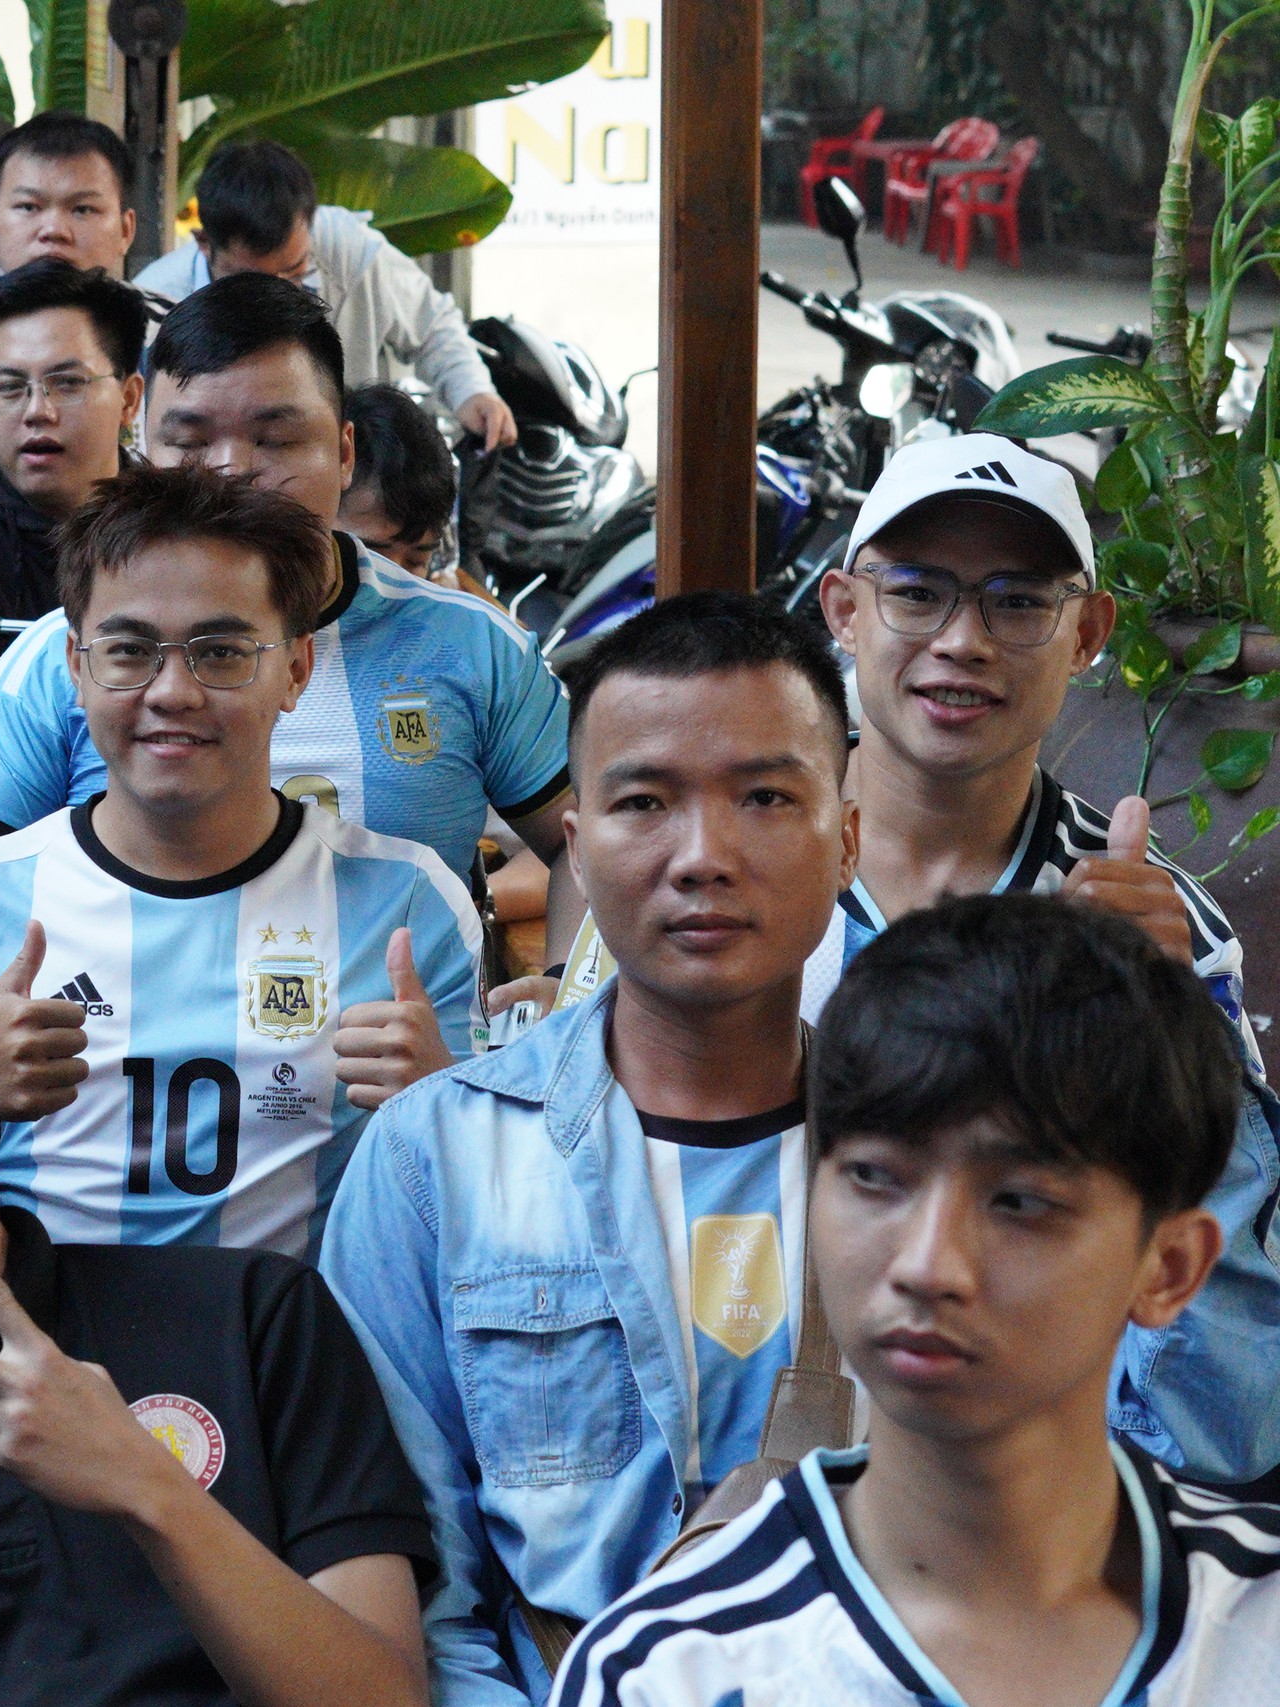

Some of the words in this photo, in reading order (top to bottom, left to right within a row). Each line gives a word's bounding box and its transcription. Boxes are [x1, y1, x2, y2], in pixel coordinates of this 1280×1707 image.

[504, 101, 650, 185] Na
[395, 711, 427, 744] AFA
[262, 975, 310, 1016] AFA
[248, 1094, 287, 1102] ARGENTINA
[298, 1096, 317, 1104] CHILE
[122, 1057, 241, 1196] 10
[722, 1303, 761, 1320] FIFA
